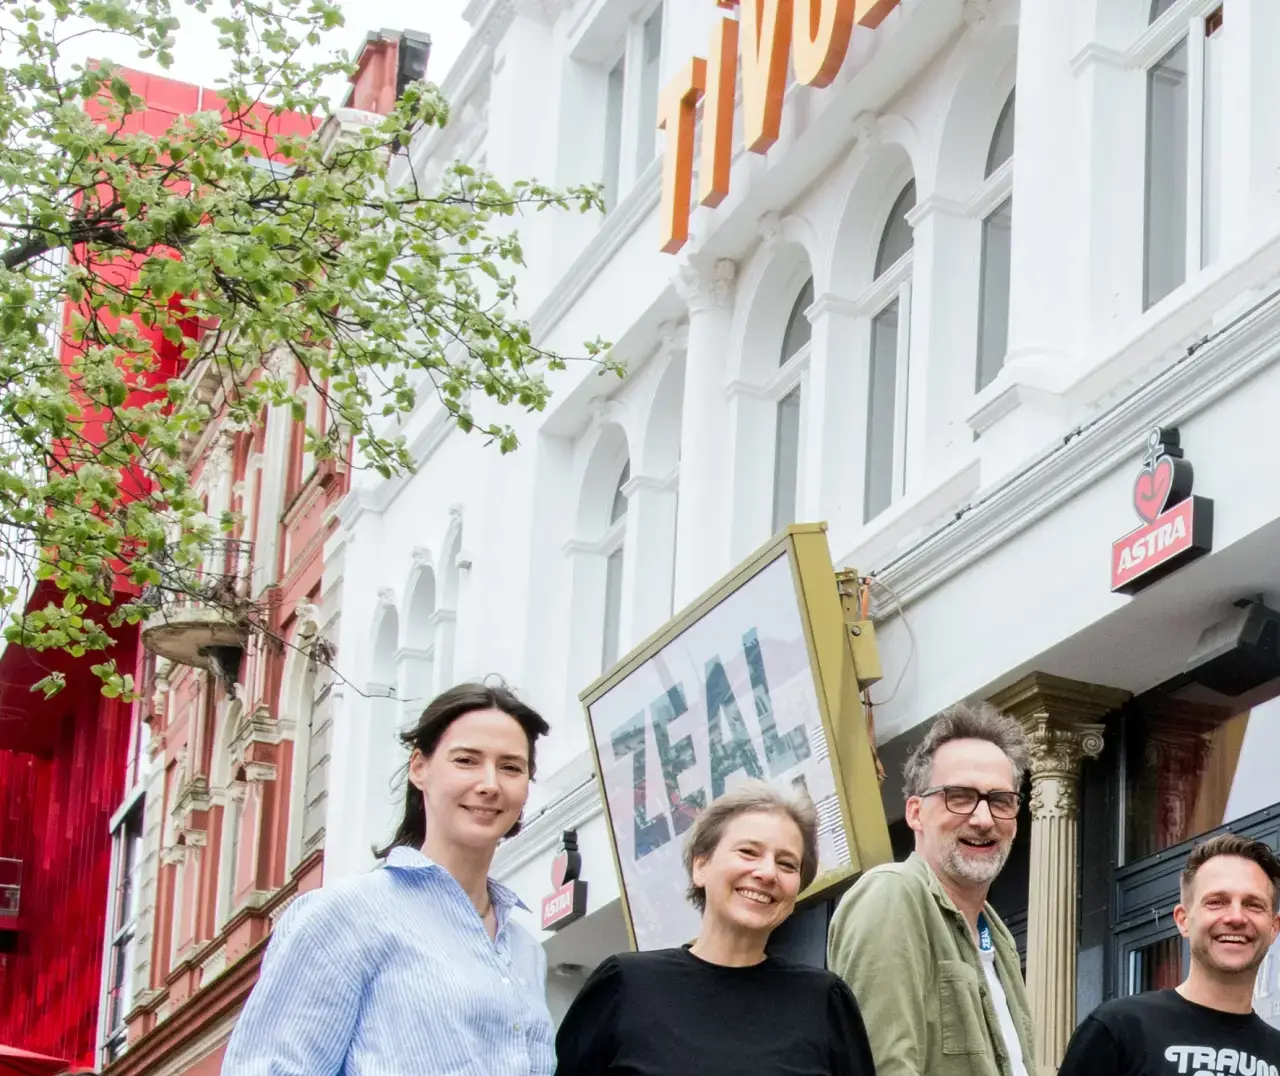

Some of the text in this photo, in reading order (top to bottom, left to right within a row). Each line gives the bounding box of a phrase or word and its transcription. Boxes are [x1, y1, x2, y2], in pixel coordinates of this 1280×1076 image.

[657, 0, 902, 255] TIV
[1117, 515, 1186, 576] ASTRA
[611, 627, 811, 862] ZEAL
